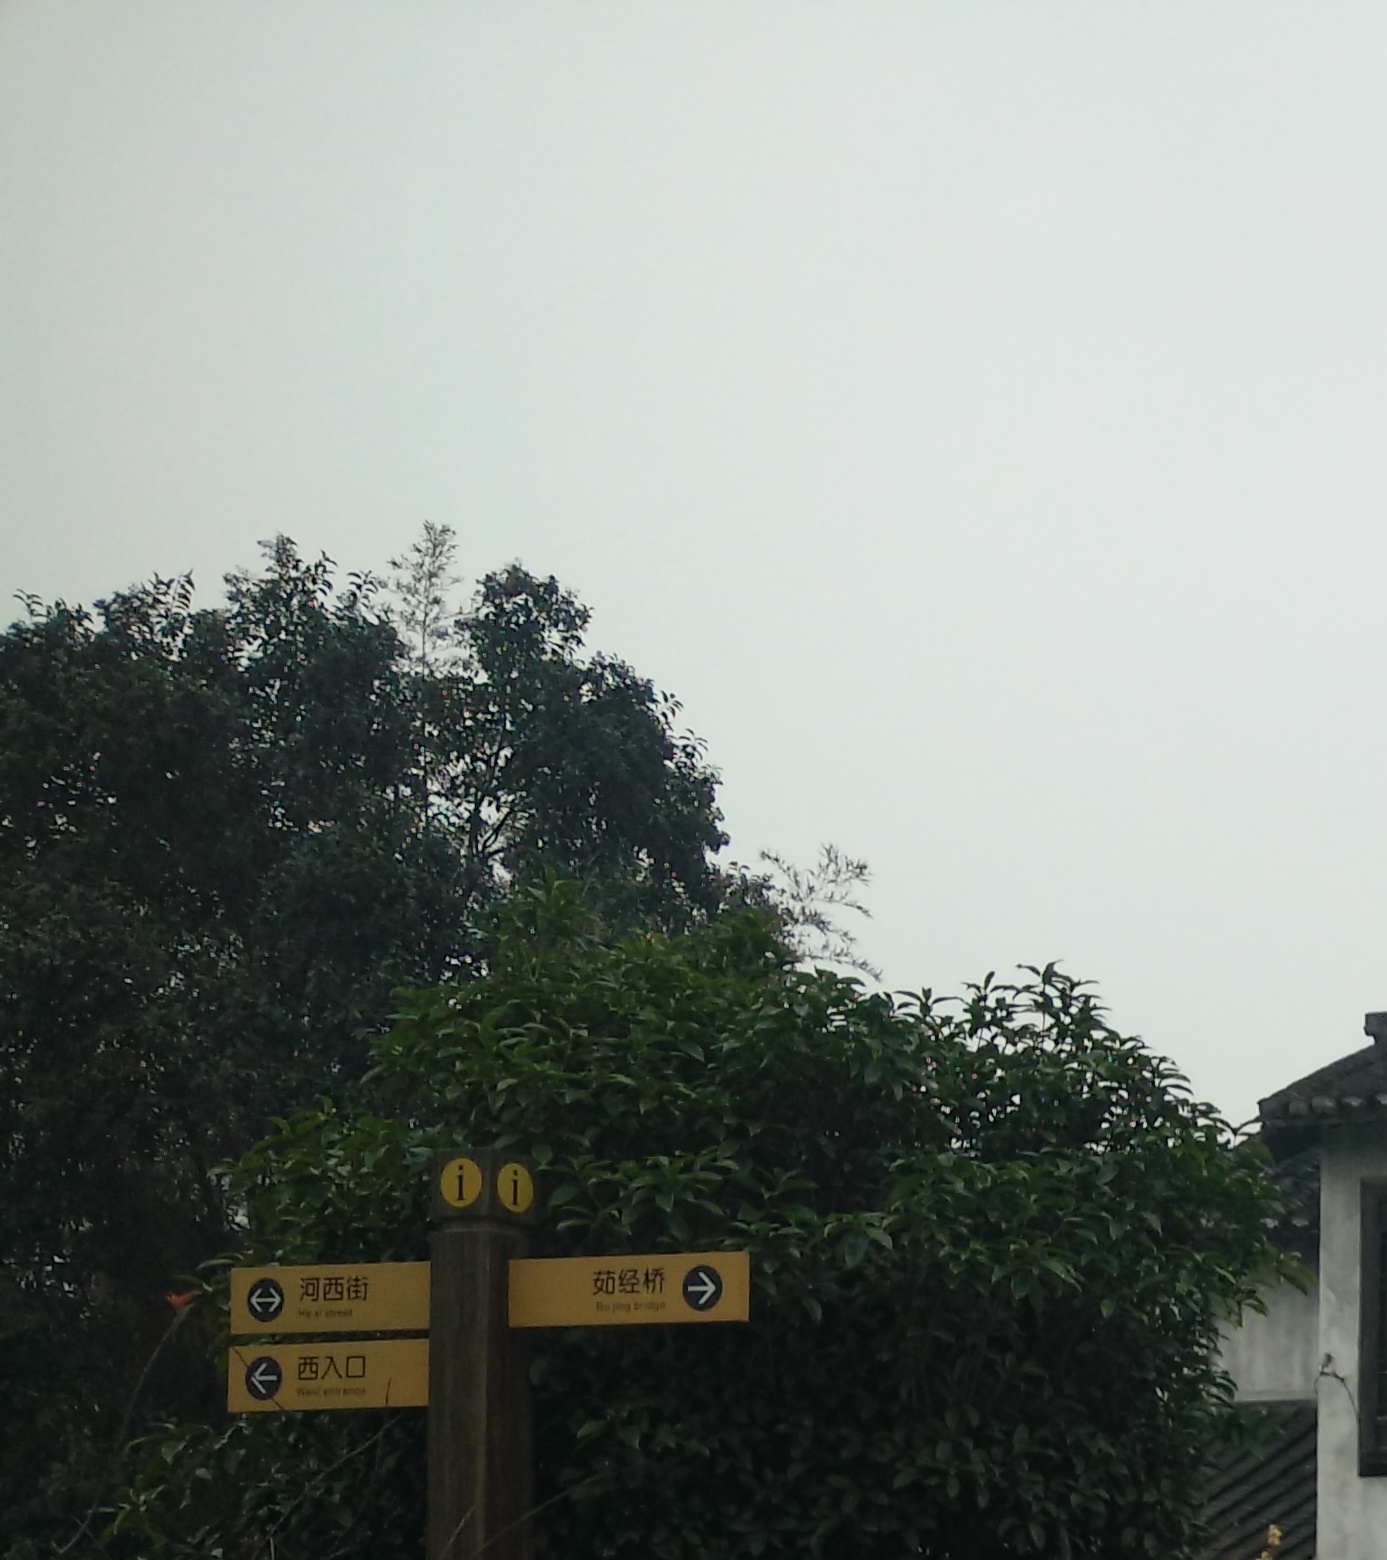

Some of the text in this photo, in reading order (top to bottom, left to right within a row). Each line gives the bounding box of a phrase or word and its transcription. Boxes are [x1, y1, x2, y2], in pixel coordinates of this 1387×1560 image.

[299, 1276, 369, 1302] 河西街
[593, 1267, 666, 1296] 茹经桥
[297, 1355, 366, 1381] 西入口
